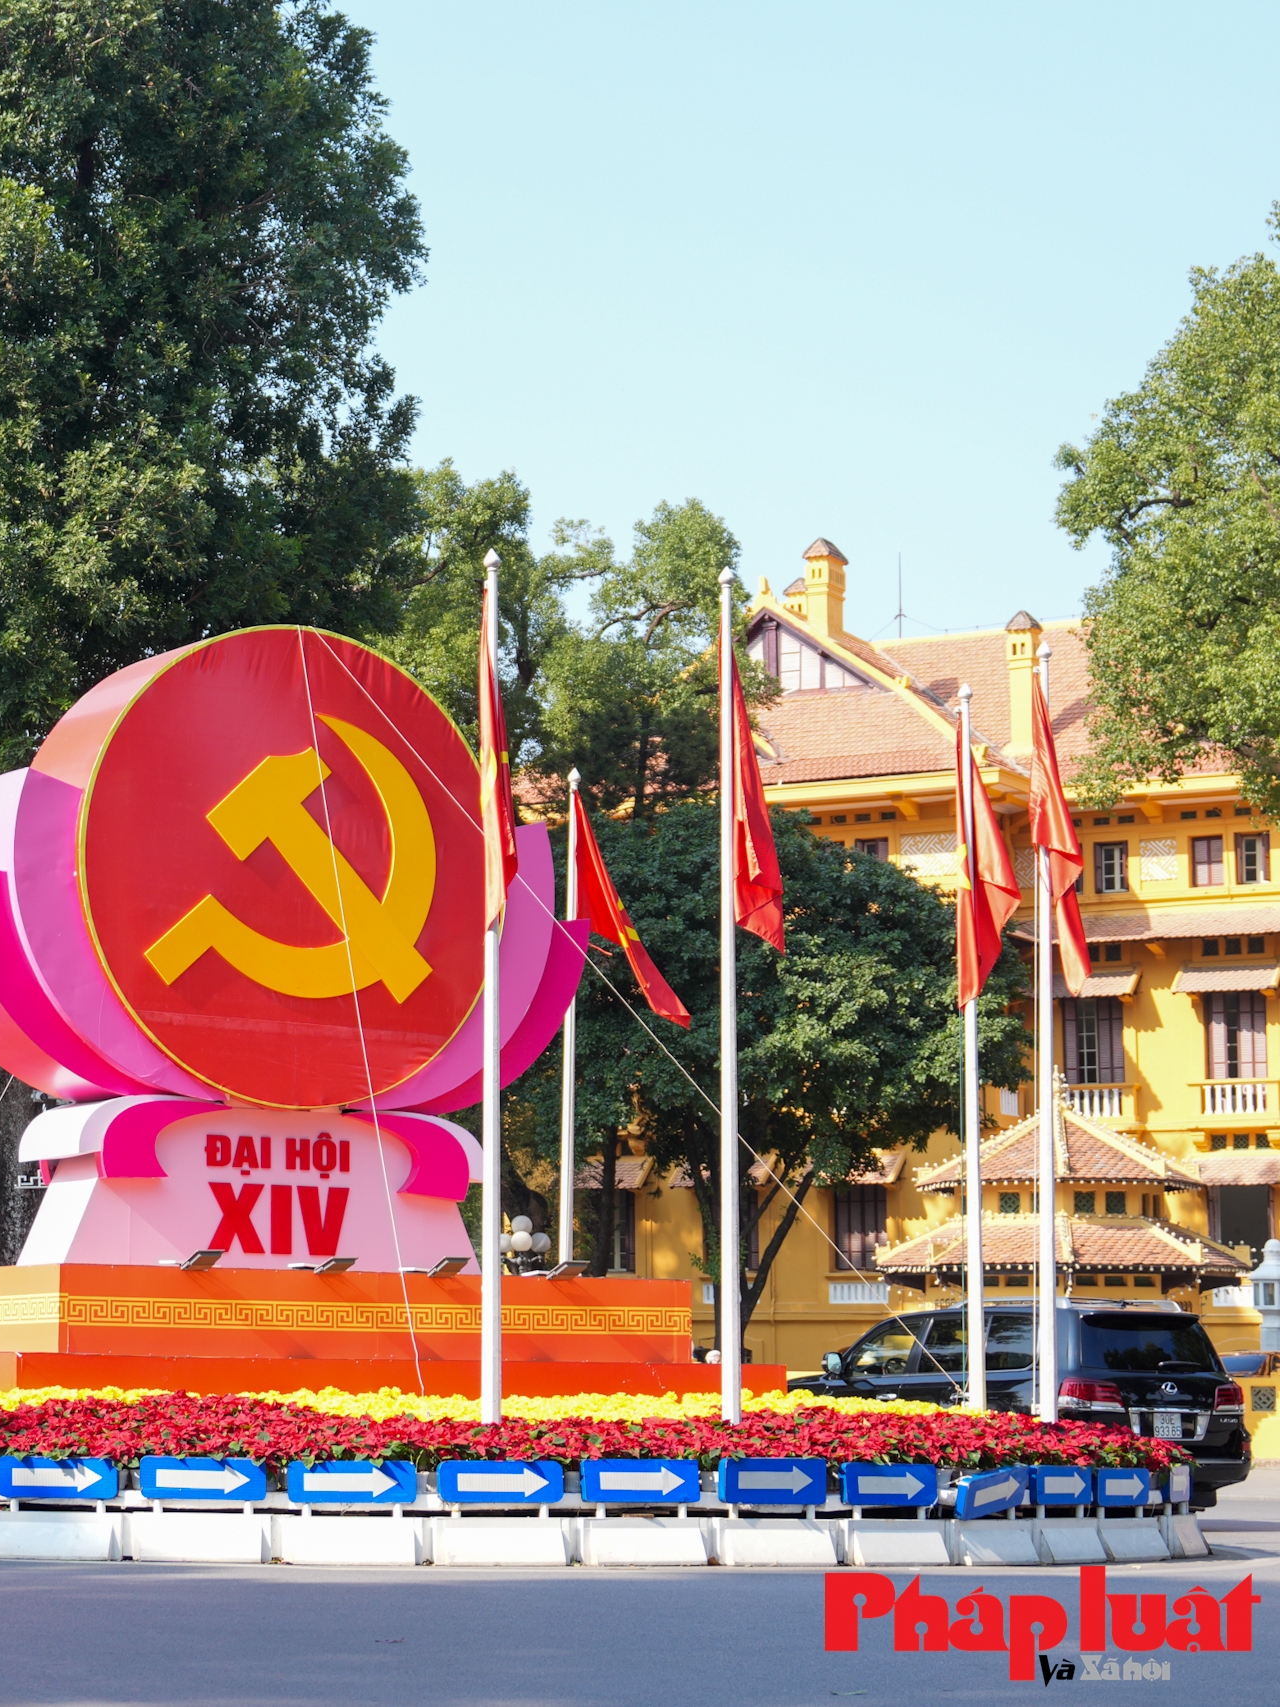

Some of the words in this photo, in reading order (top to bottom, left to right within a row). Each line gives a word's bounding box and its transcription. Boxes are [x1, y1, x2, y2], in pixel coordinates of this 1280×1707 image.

[205, 1134, 271, 1175] ĐẠI
[286, 1132, 350, 1179] HỘI
[208, 1182, 350, 1256] XIV
[1154, 1426, 1181, 1437] 933.65
[1160, 1414, 1175, 1425] 30E
